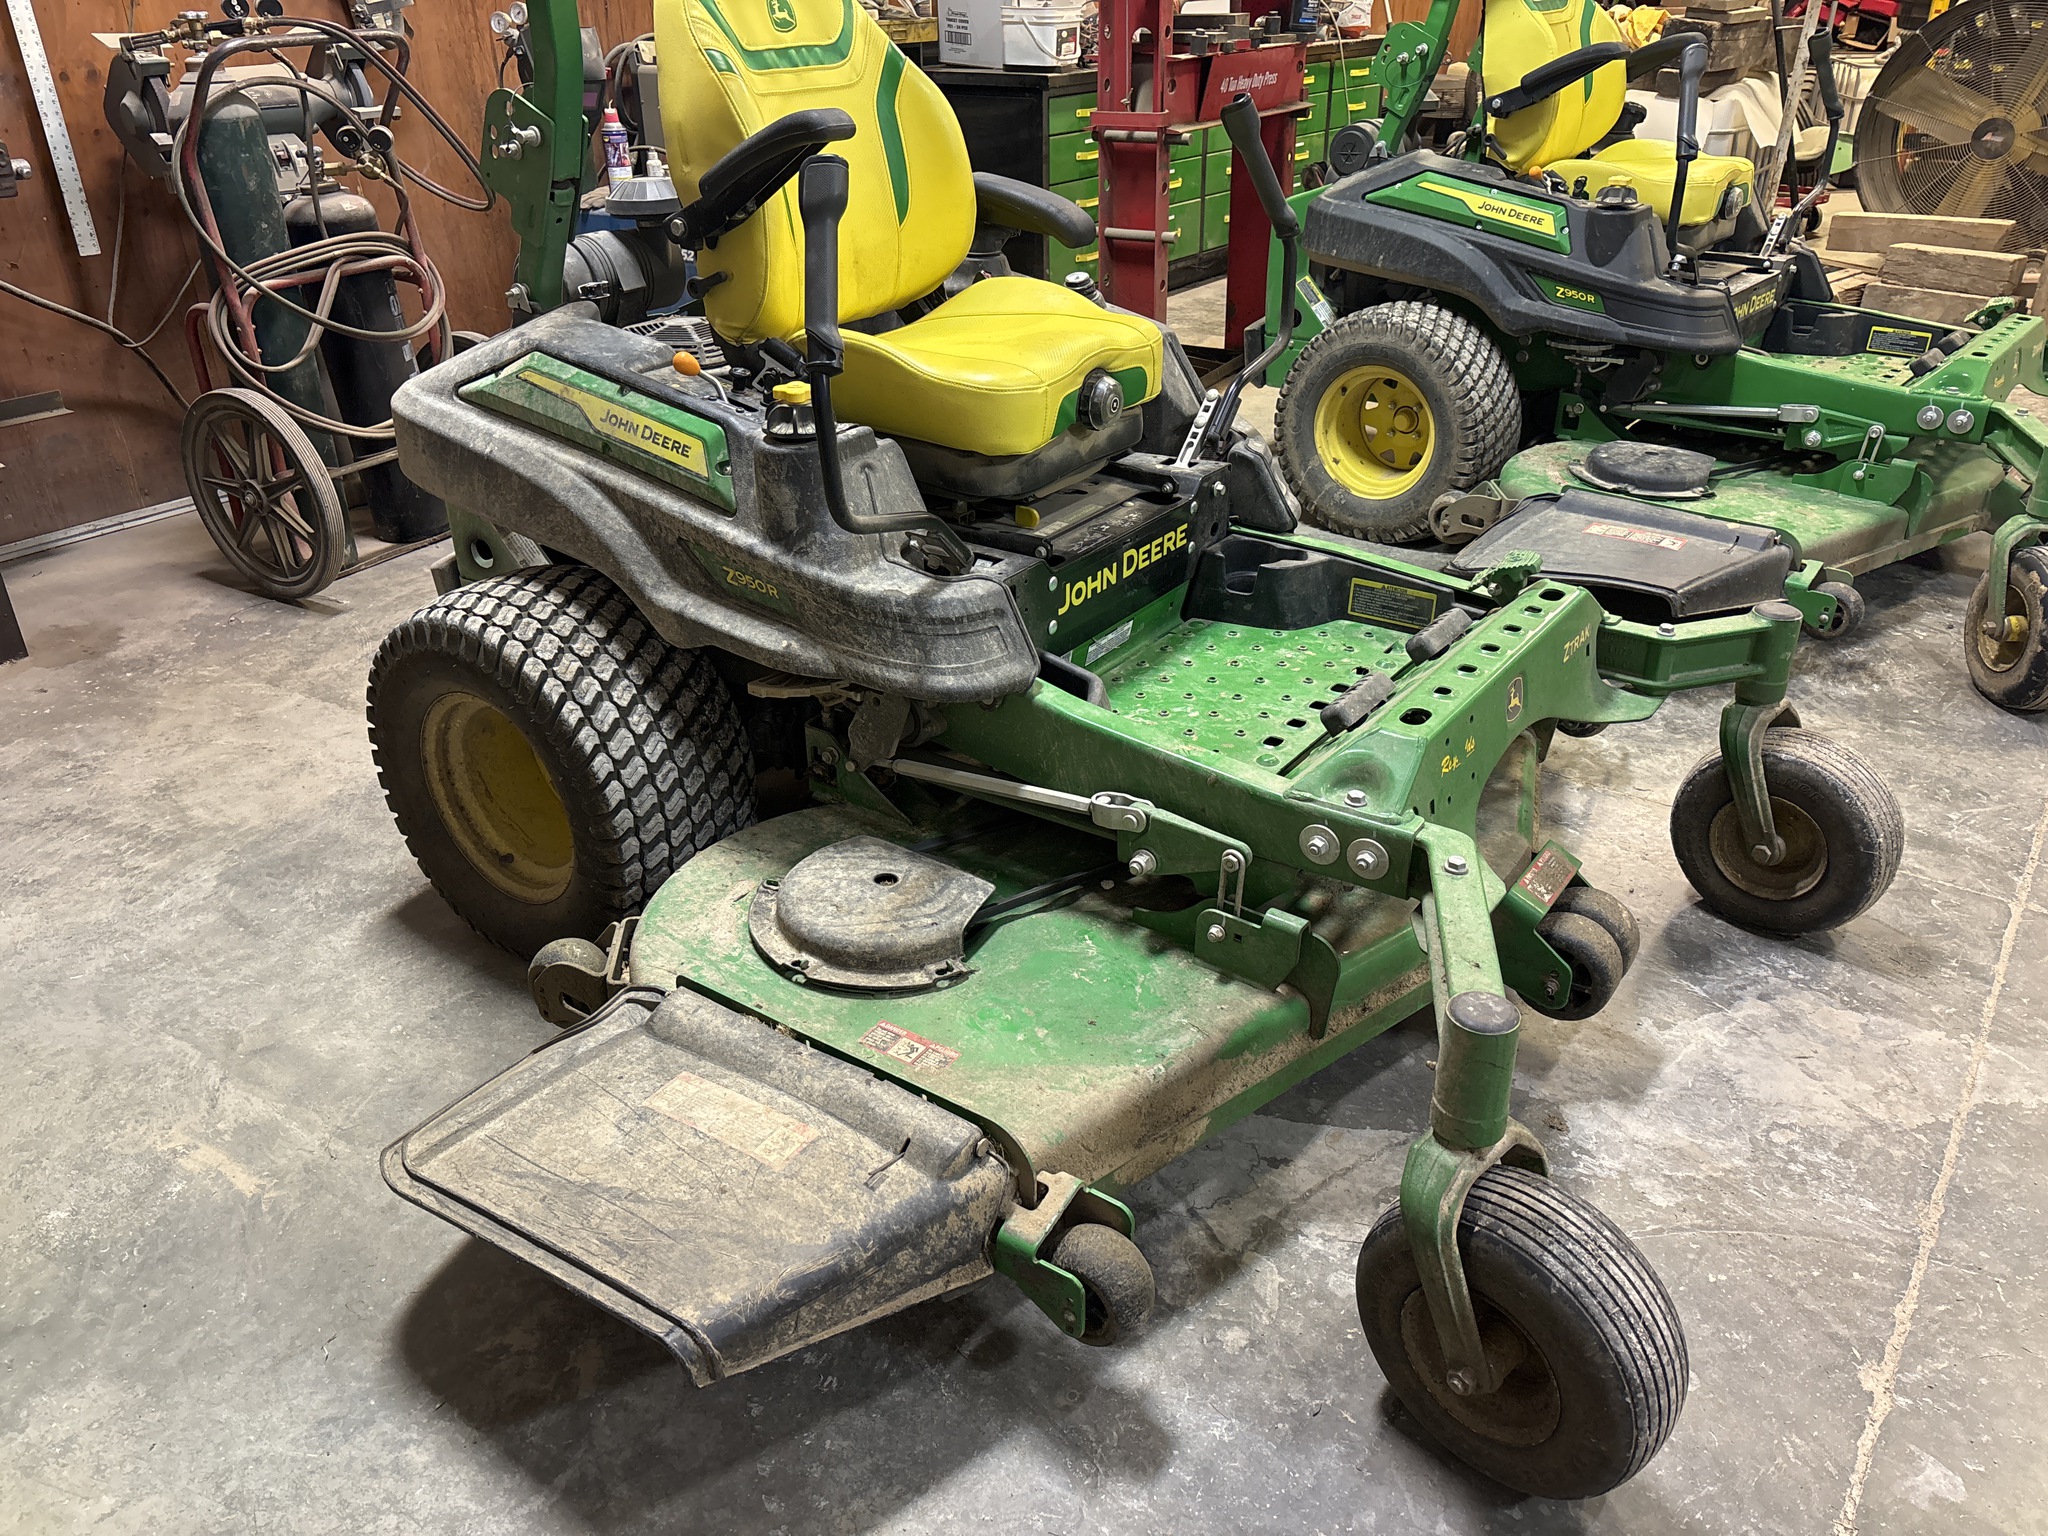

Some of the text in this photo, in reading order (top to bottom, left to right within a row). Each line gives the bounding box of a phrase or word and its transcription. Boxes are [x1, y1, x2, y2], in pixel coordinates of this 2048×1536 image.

[1228, 77, 1238, 92] Ton
[1236, 75, 1252, 91] Heavy
[1252, 73, 1264, 89] Duty
[1263, 71, 1279, 87] Press
[1478, 201, 1545, 226] JOHN DEERE
[1555, 286, 1596, 304] Z950R
[1749, 288, 1776, 314] DEERE
[600, 409, 692, 458] JOHN DEERE
[722, 565, 780, 600] Z950R
[1058, 562, 1118, 616] JOHN
[1122, 522, 1188, 579] DEERE
[1563, 623, 1591, 664] ZTRAK
